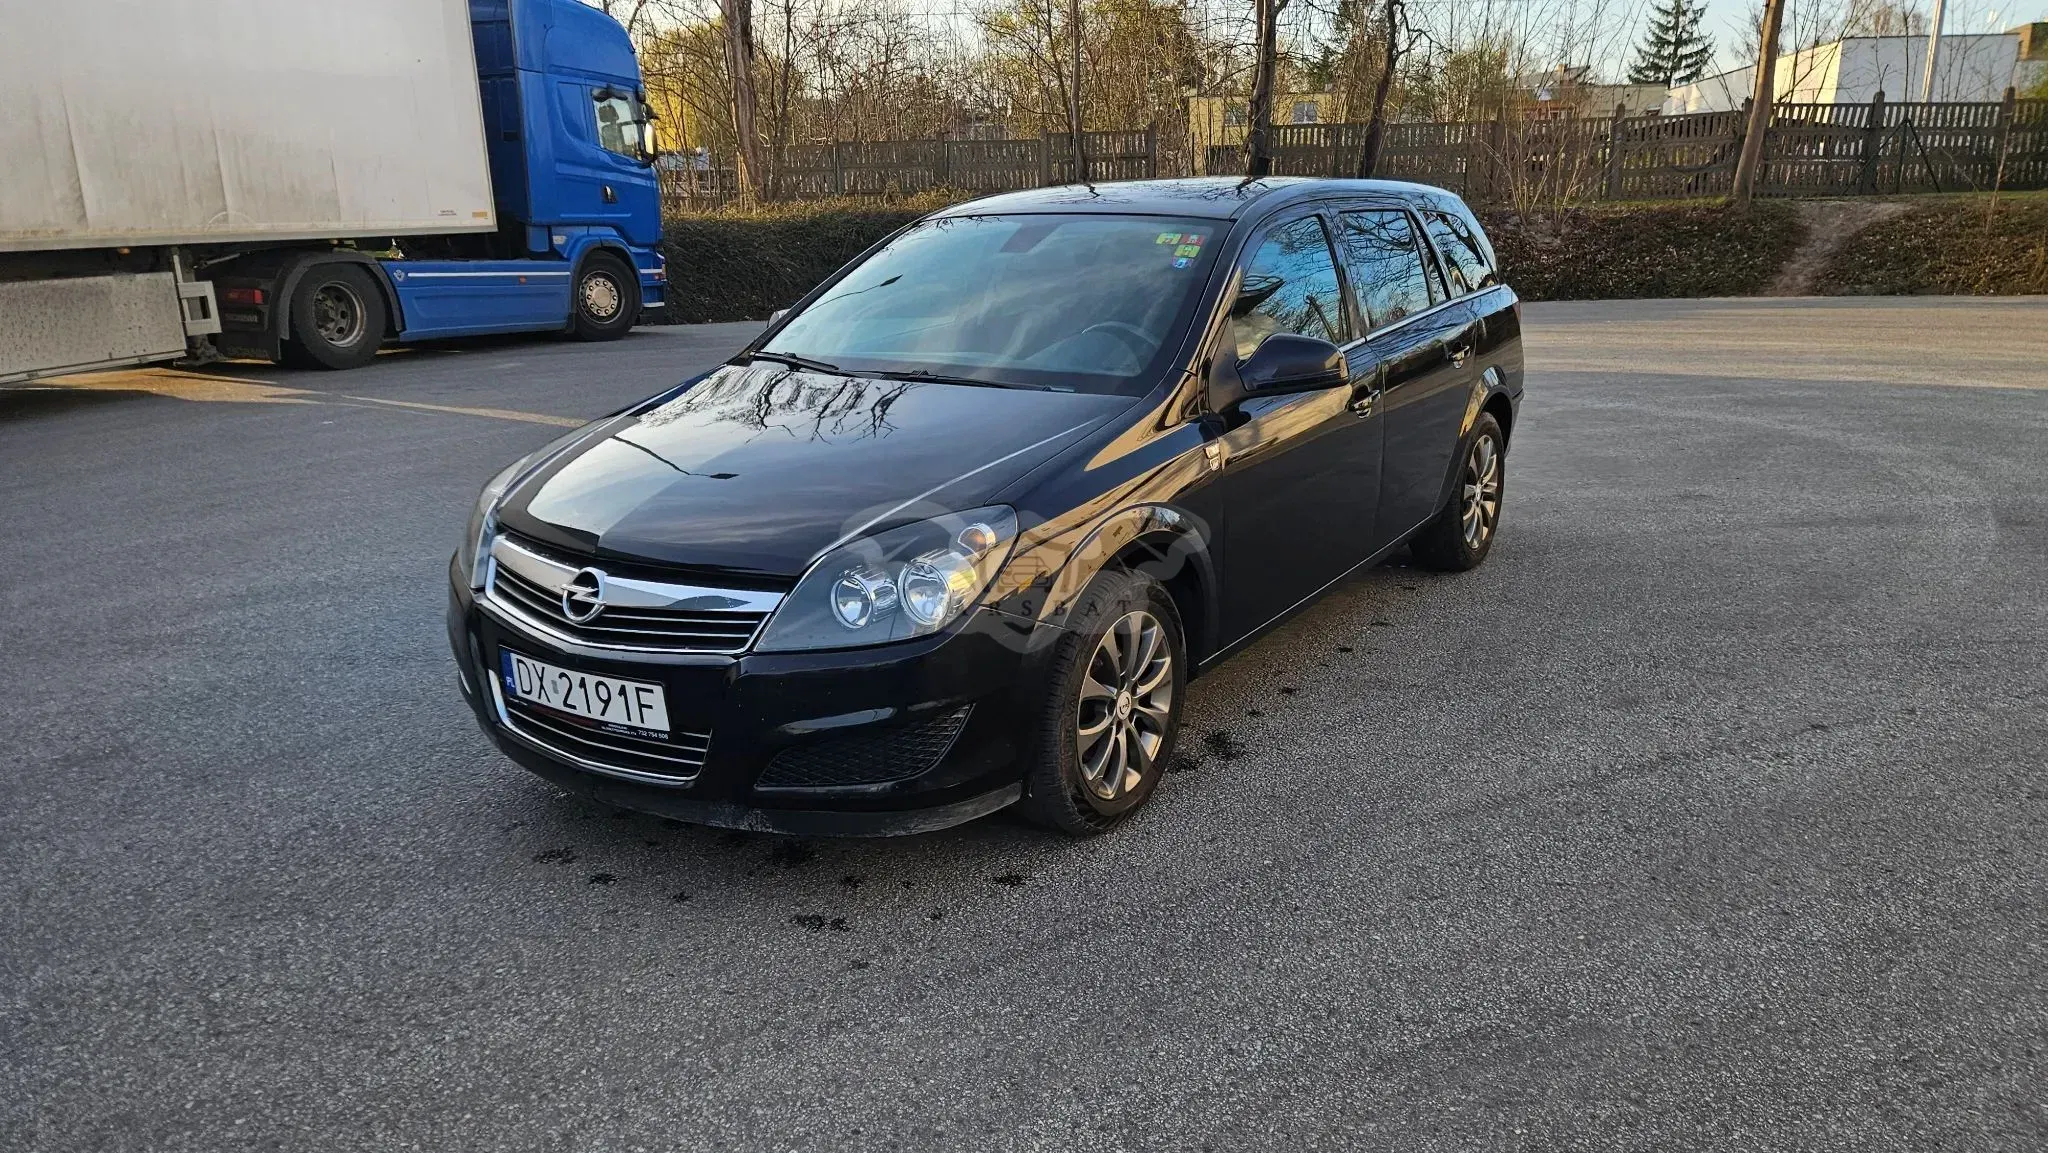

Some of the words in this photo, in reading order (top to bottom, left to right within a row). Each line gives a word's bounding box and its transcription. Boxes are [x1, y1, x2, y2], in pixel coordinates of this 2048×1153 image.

[506, 676, 515, 688] PL
[516, 658, 551, 703] DX
[558, 672, 654, 724] 2191F
